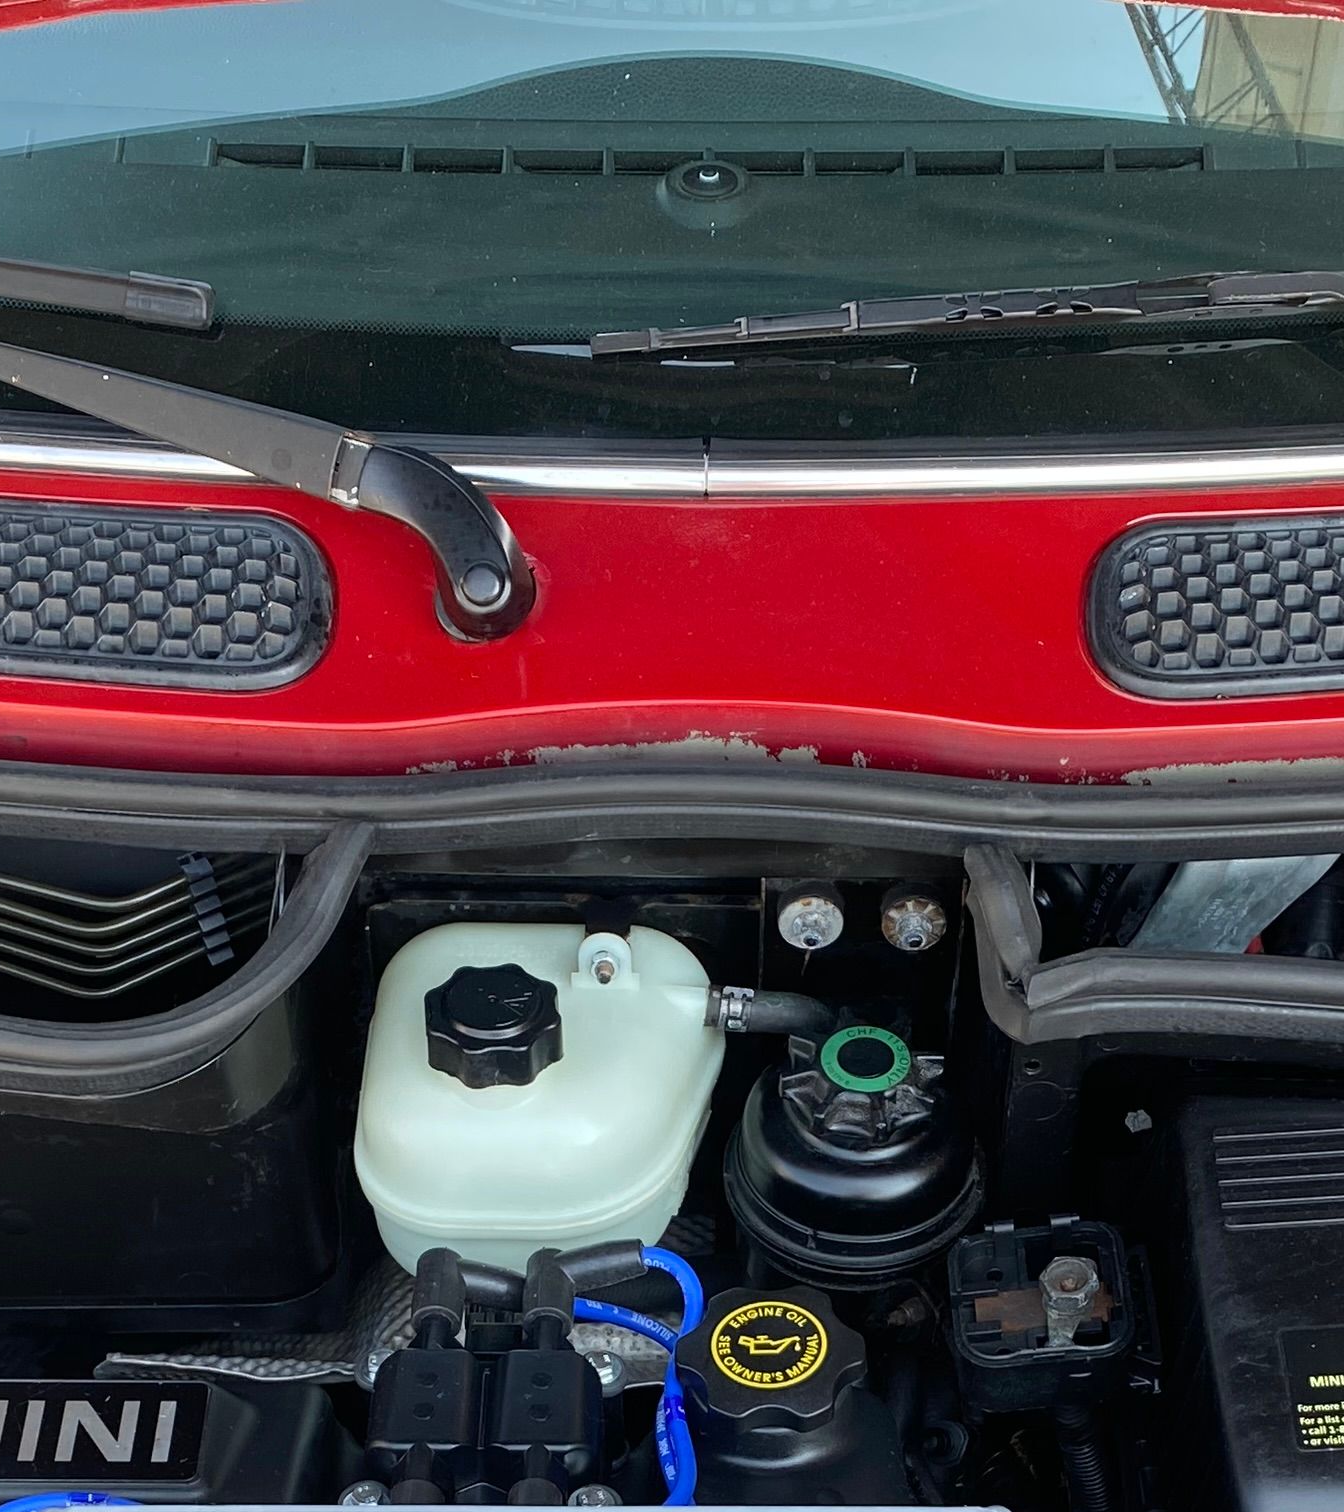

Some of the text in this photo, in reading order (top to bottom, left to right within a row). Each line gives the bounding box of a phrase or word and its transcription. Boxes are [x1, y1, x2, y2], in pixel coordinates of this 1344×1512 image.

[846, 1028, 877, 1038] CHF
[729, 1307, 808, 1329] ENGINE OIL
[630, 1312, 674, 1341] SILICONE
[718, 1334, 819, 1382] SEE OWNER'S MANUAL
[1309, 1374, 1344, 1387] MINI
[1297, 1404, 1312, 1412] For
[1314, 1403, 1340, 1411] more
[1299, 1417, 1315, 1425] For
[1324, 1415, 1339, 1424] list
[1308, 1425, 1327, 1435] call
[1310, 1438, 1321, 1446] or
